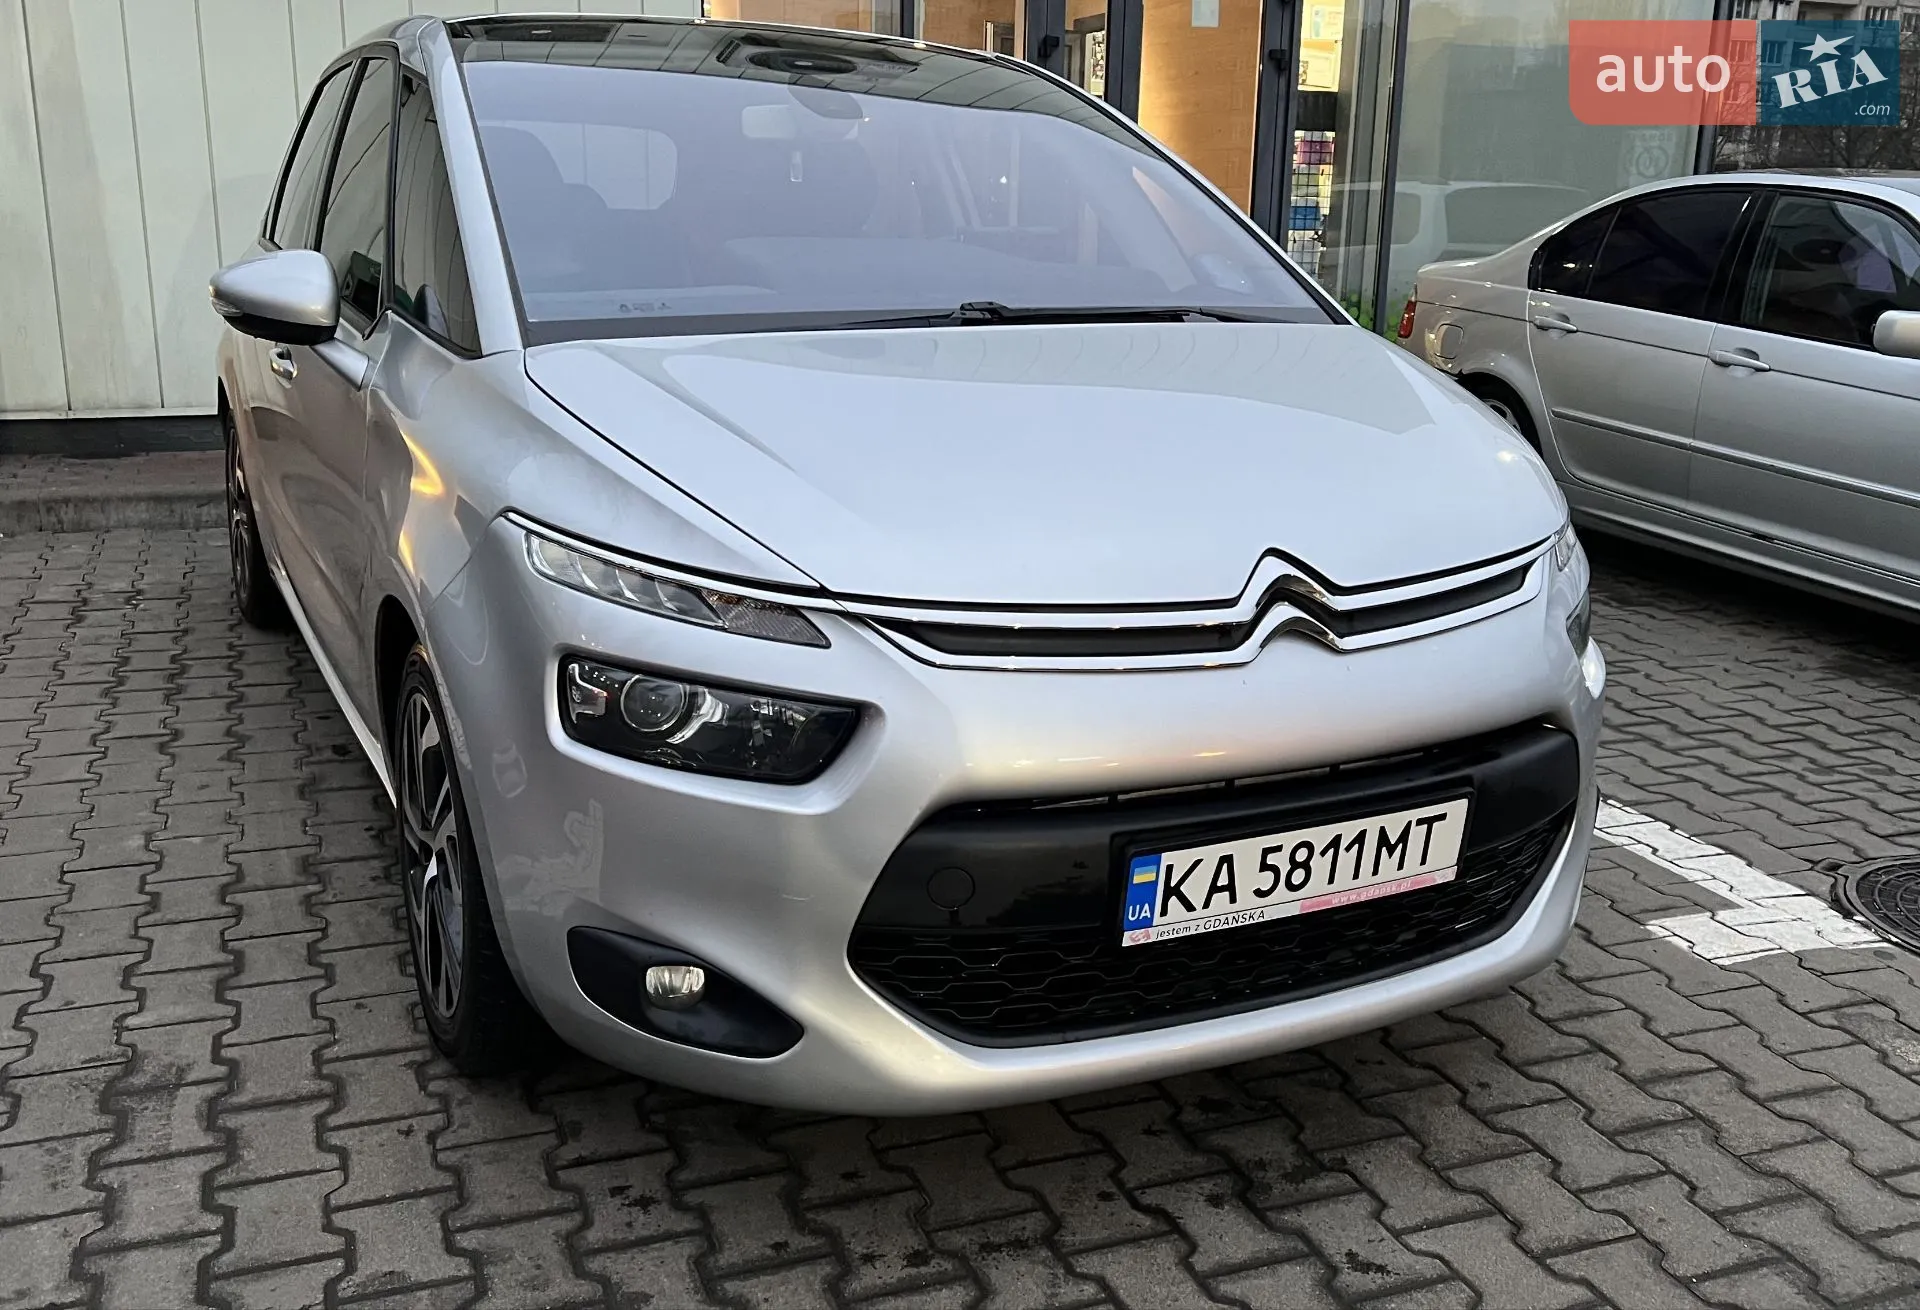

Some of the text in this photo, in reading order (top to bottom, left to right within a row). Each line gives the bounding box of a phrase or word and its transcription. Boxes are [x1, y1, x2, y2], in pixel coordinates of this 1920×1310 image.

[1159, 853, 1238, 918] KA
[1128, 903, 1151, 921] UA
[1155, 925, 1191, 940] jestem
[1194, 924, 1201, 932] z
